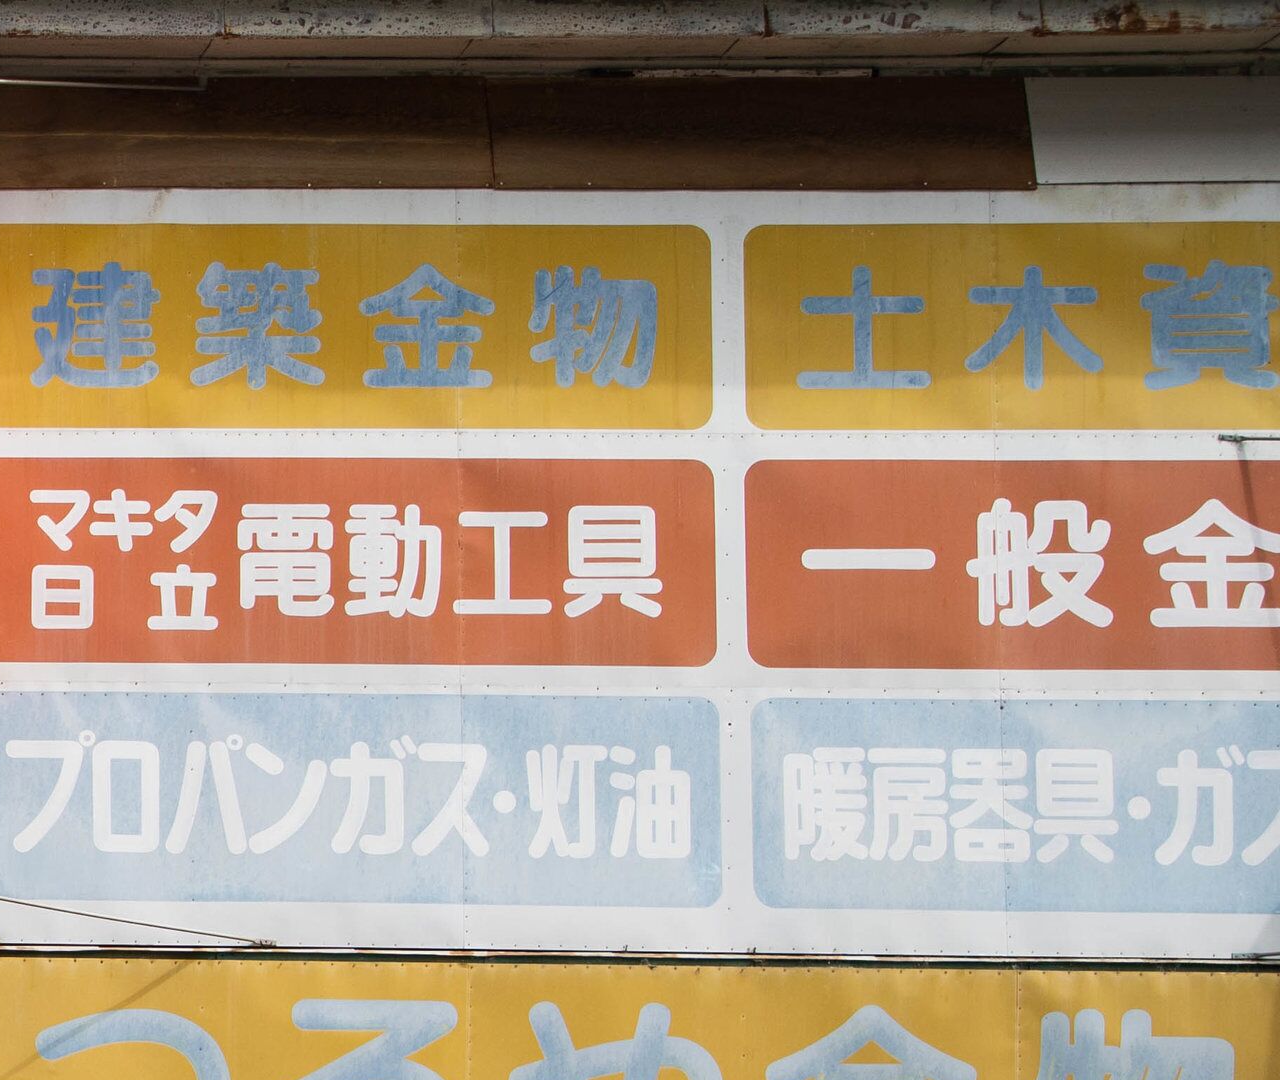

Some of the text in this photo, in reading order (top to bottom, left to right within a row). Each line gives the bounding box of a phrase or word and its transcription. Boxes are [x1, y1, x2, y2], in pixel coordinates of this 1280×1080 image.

[29, 261, 659, 391] 建築金物
[796, 260, 1280, 391] 土木資
[29, 488, 219, 554] マキタ
[237, 504, 663, 619] 電動工具
[801, 498, 1280, 628] 一般金
[31, 564, 218, 632] 日立
[5, 730, 691, 858] プロパンガス・灯油
